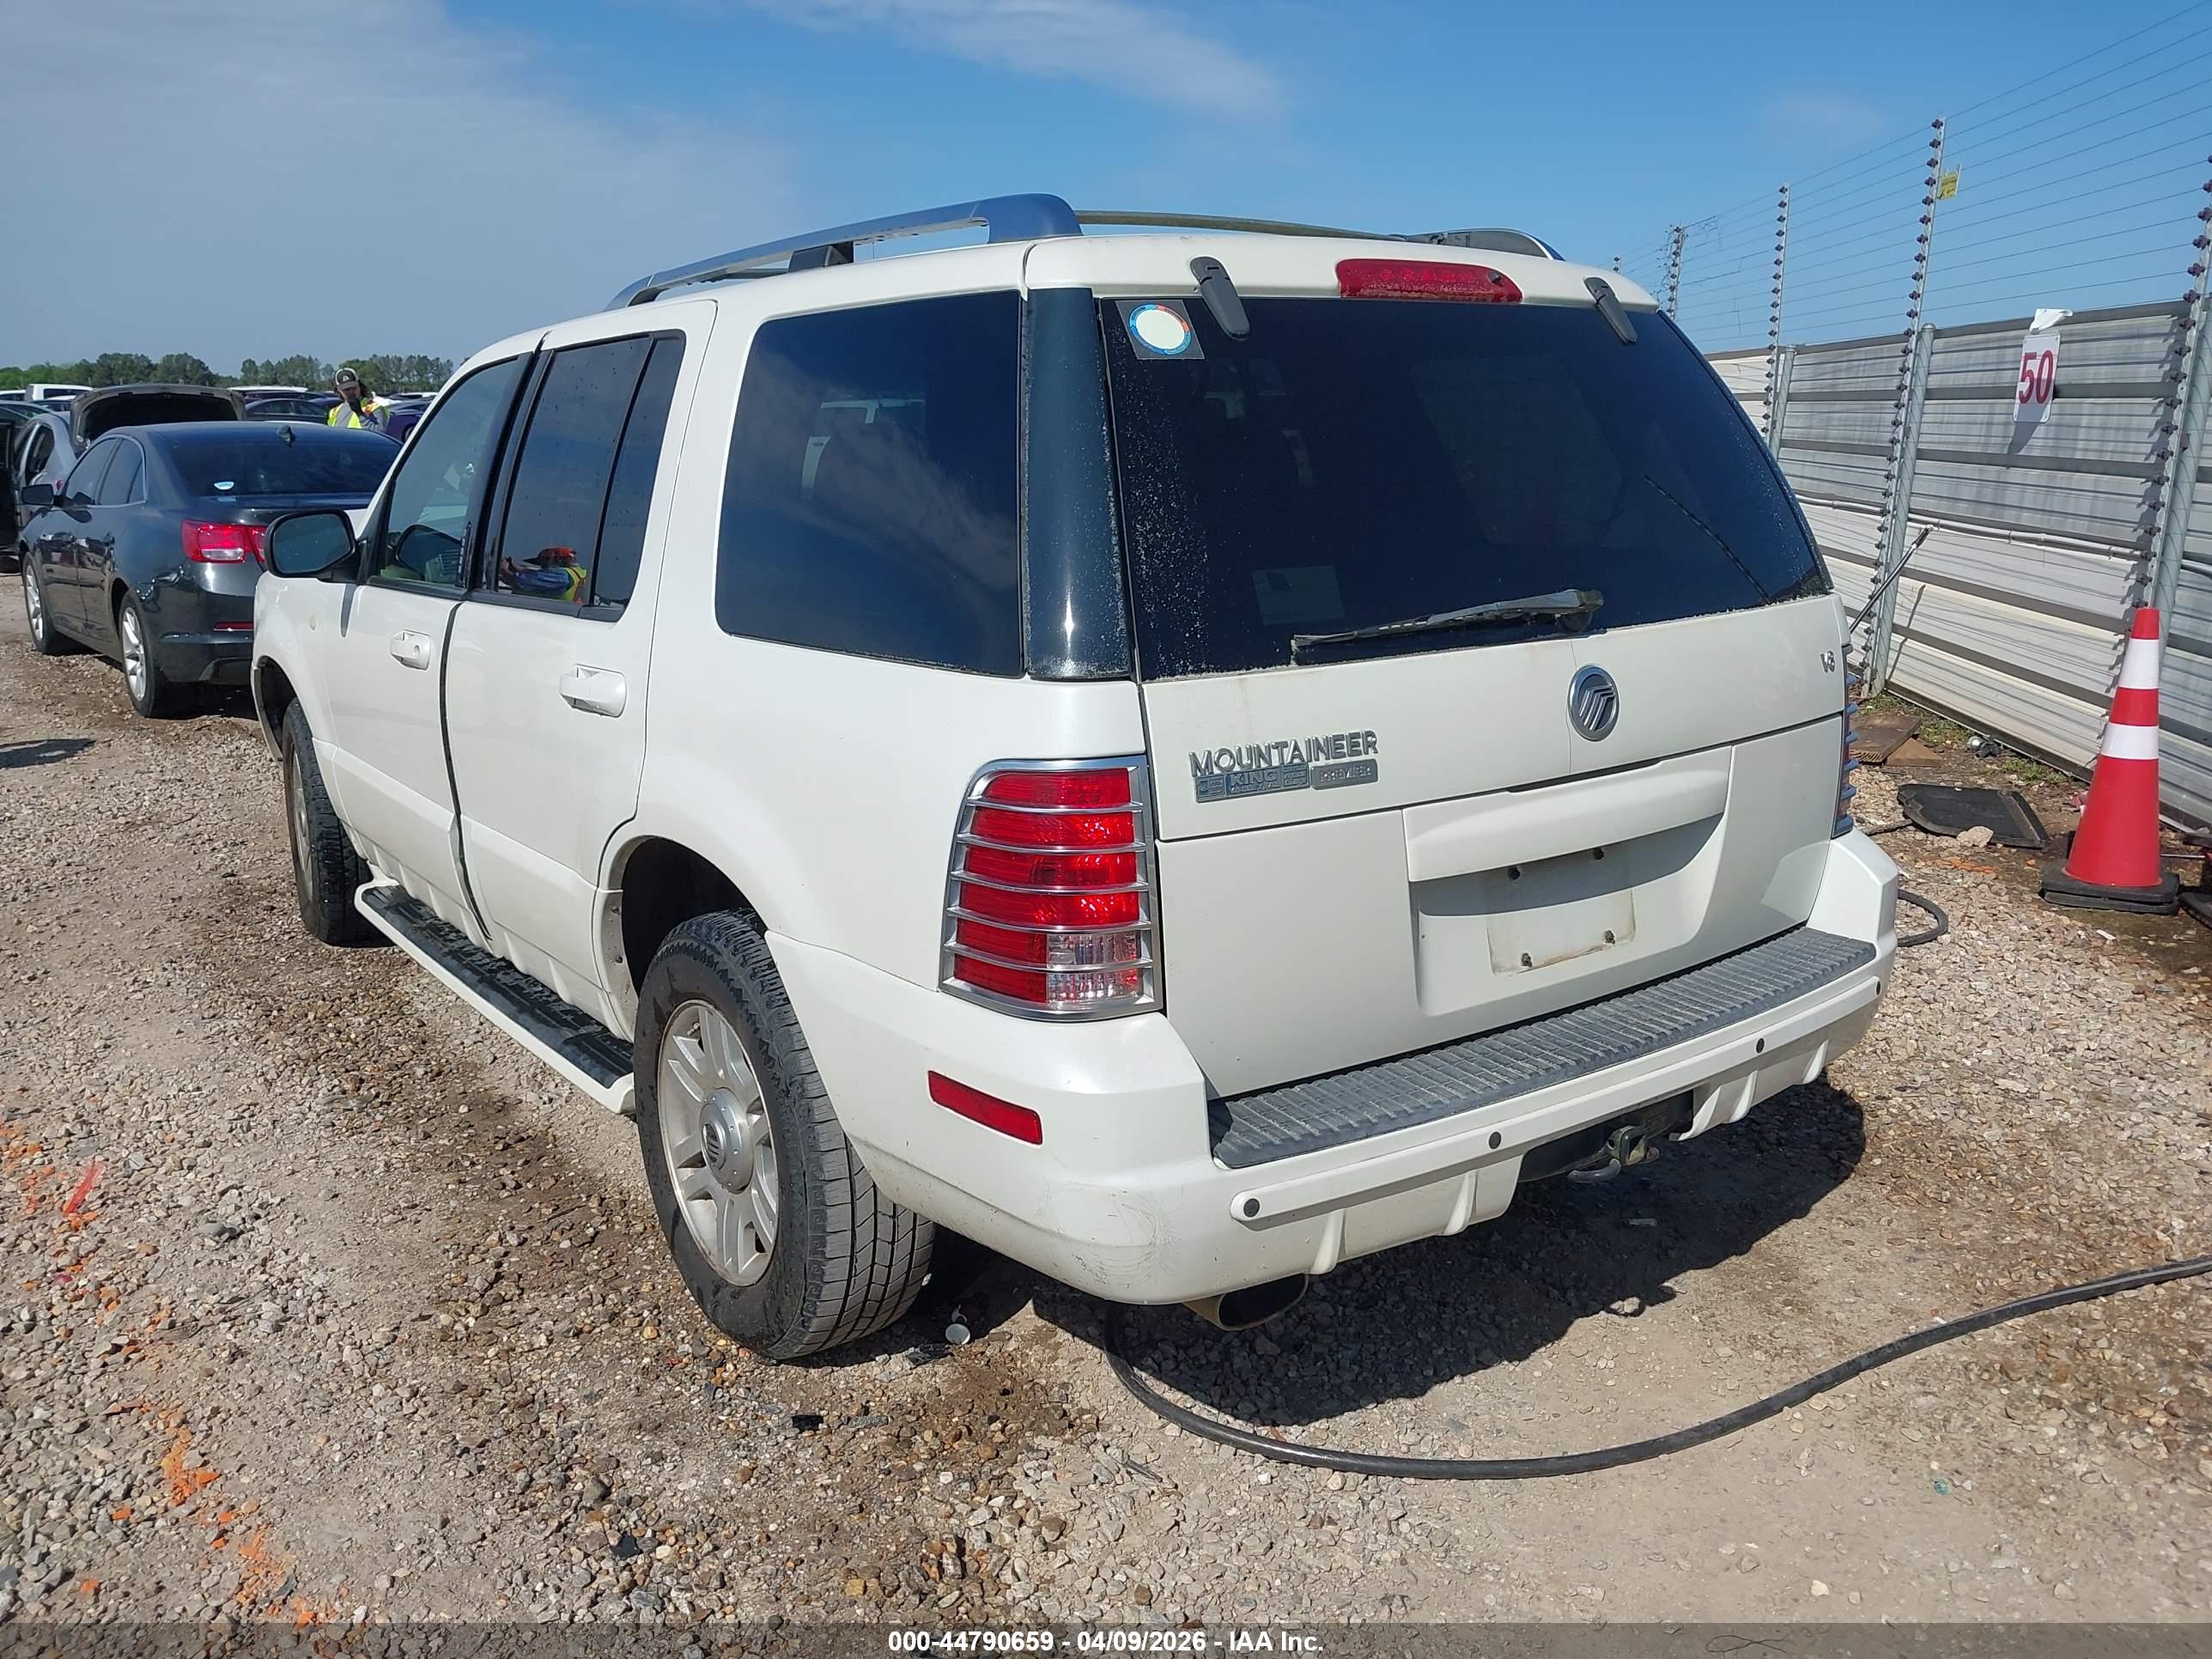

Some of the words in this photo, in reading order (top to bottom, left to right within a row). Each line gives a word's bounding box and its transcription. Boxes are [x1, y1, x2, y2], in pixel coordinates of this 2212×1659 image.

[2019, 350, 2054, 404] 50
[1820, 650, 1835, 673] V8
[1188, 730, 1378, 777] MOUNTAINEER
